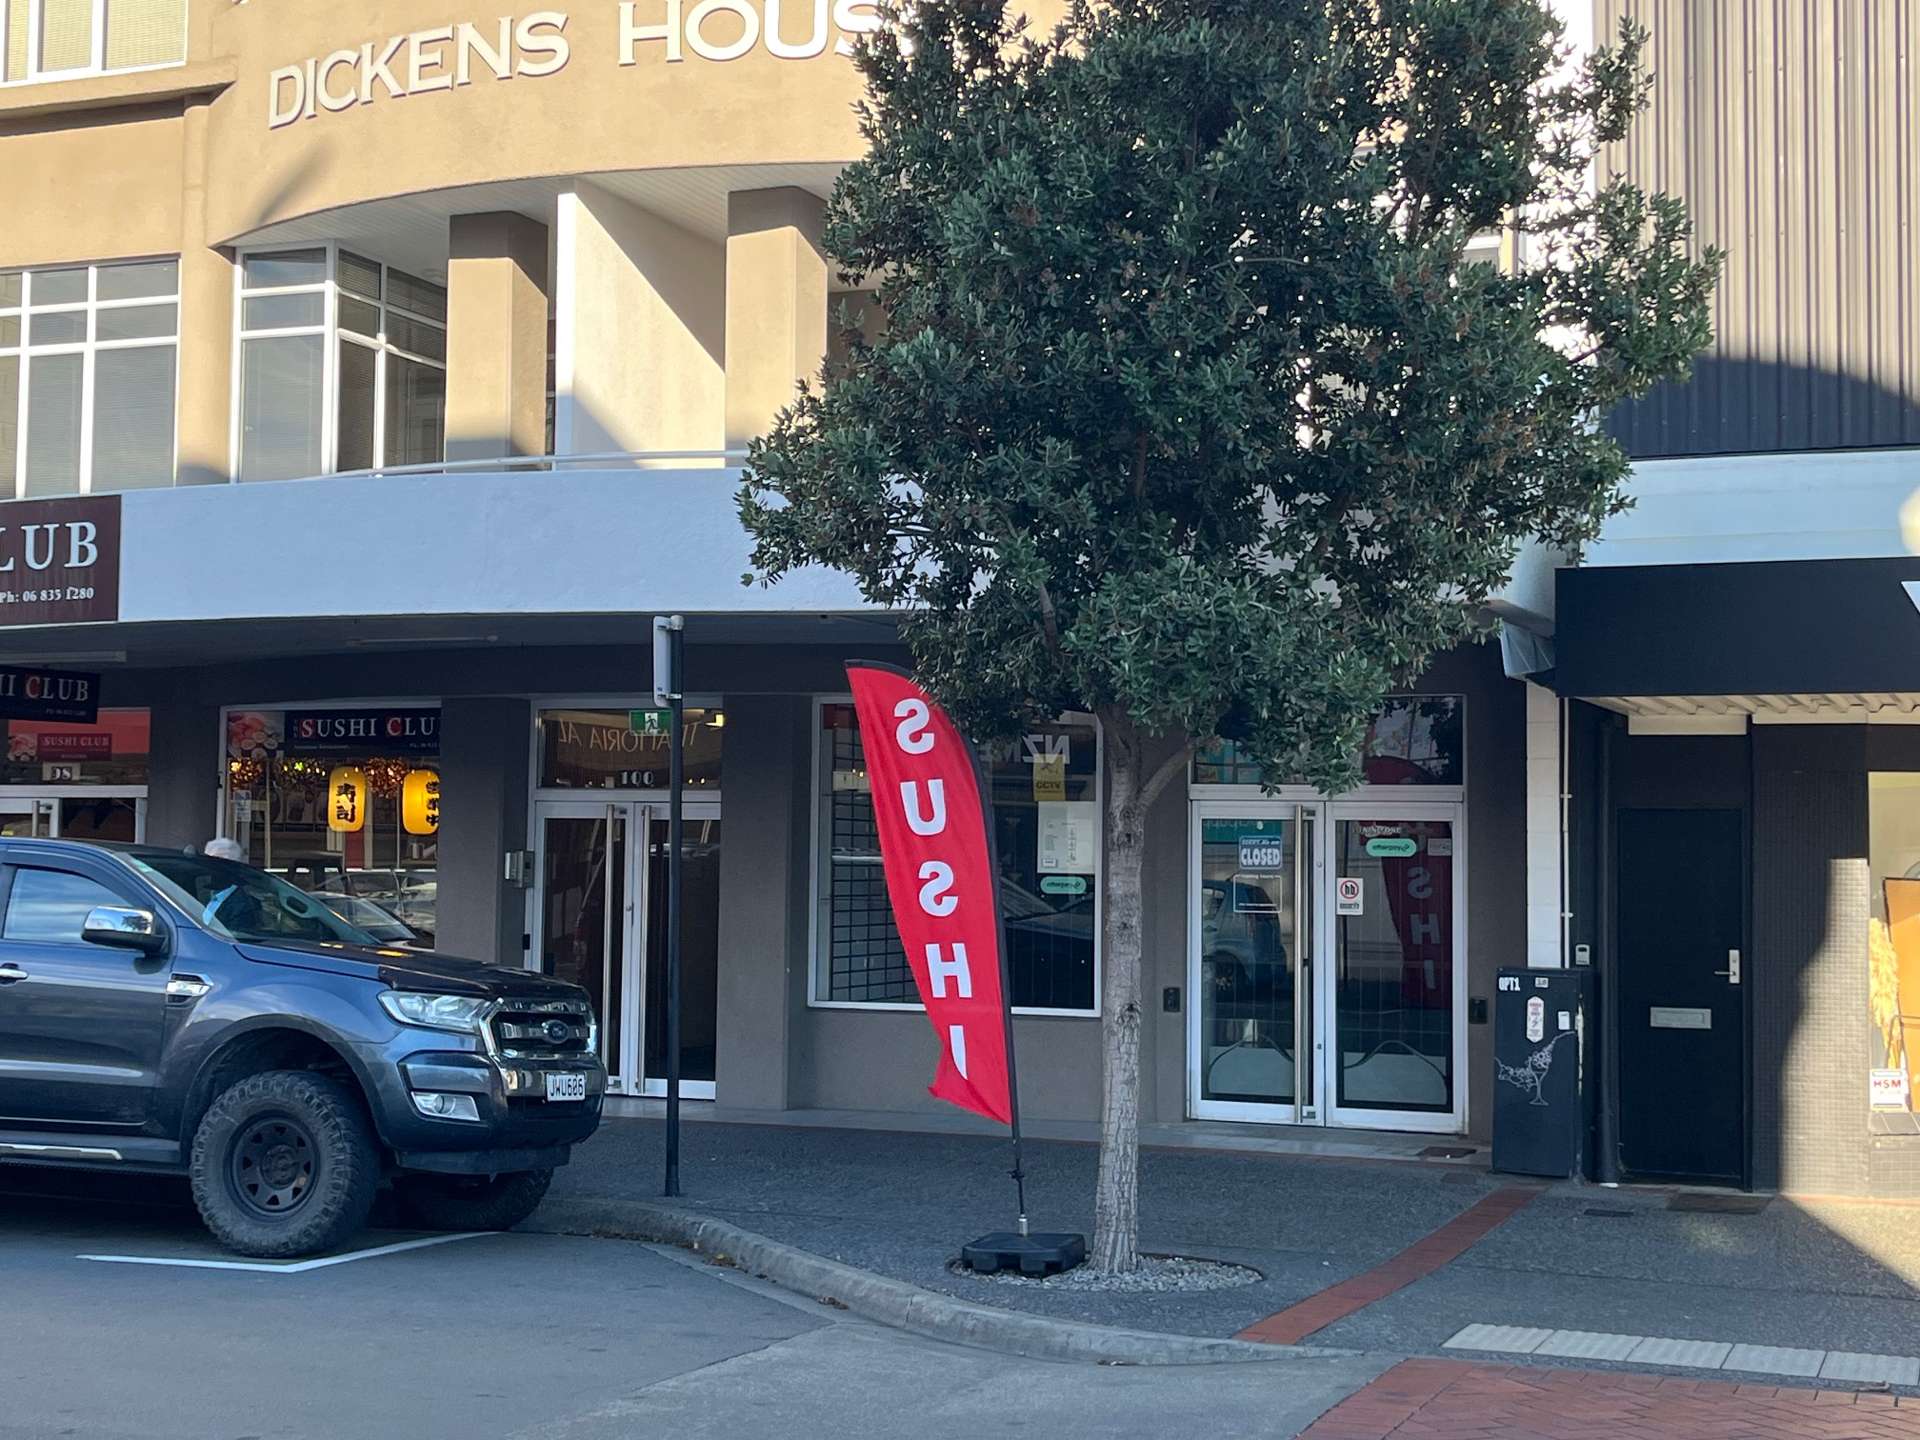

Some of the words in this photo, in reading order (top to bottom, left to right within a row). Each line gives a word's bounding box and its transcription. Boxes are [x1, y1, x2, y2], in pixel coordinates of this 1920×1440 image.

[269, 10, 570, 130] DICKENS
[23, 590, 37, 602] 06
[40, 588, 61, 601] 835
[25, 675, 89, 702] CLUB
[301, 717, 377, 738] SUSHI
[387, 716, 440, 737] CLU
[43, 736, 77, 747] SUSHI
[620, 770, 655, 786] 100
[1241, 848, 1280, 866] CLOSED
[1873, 1079, 1901, 1089] HSM
